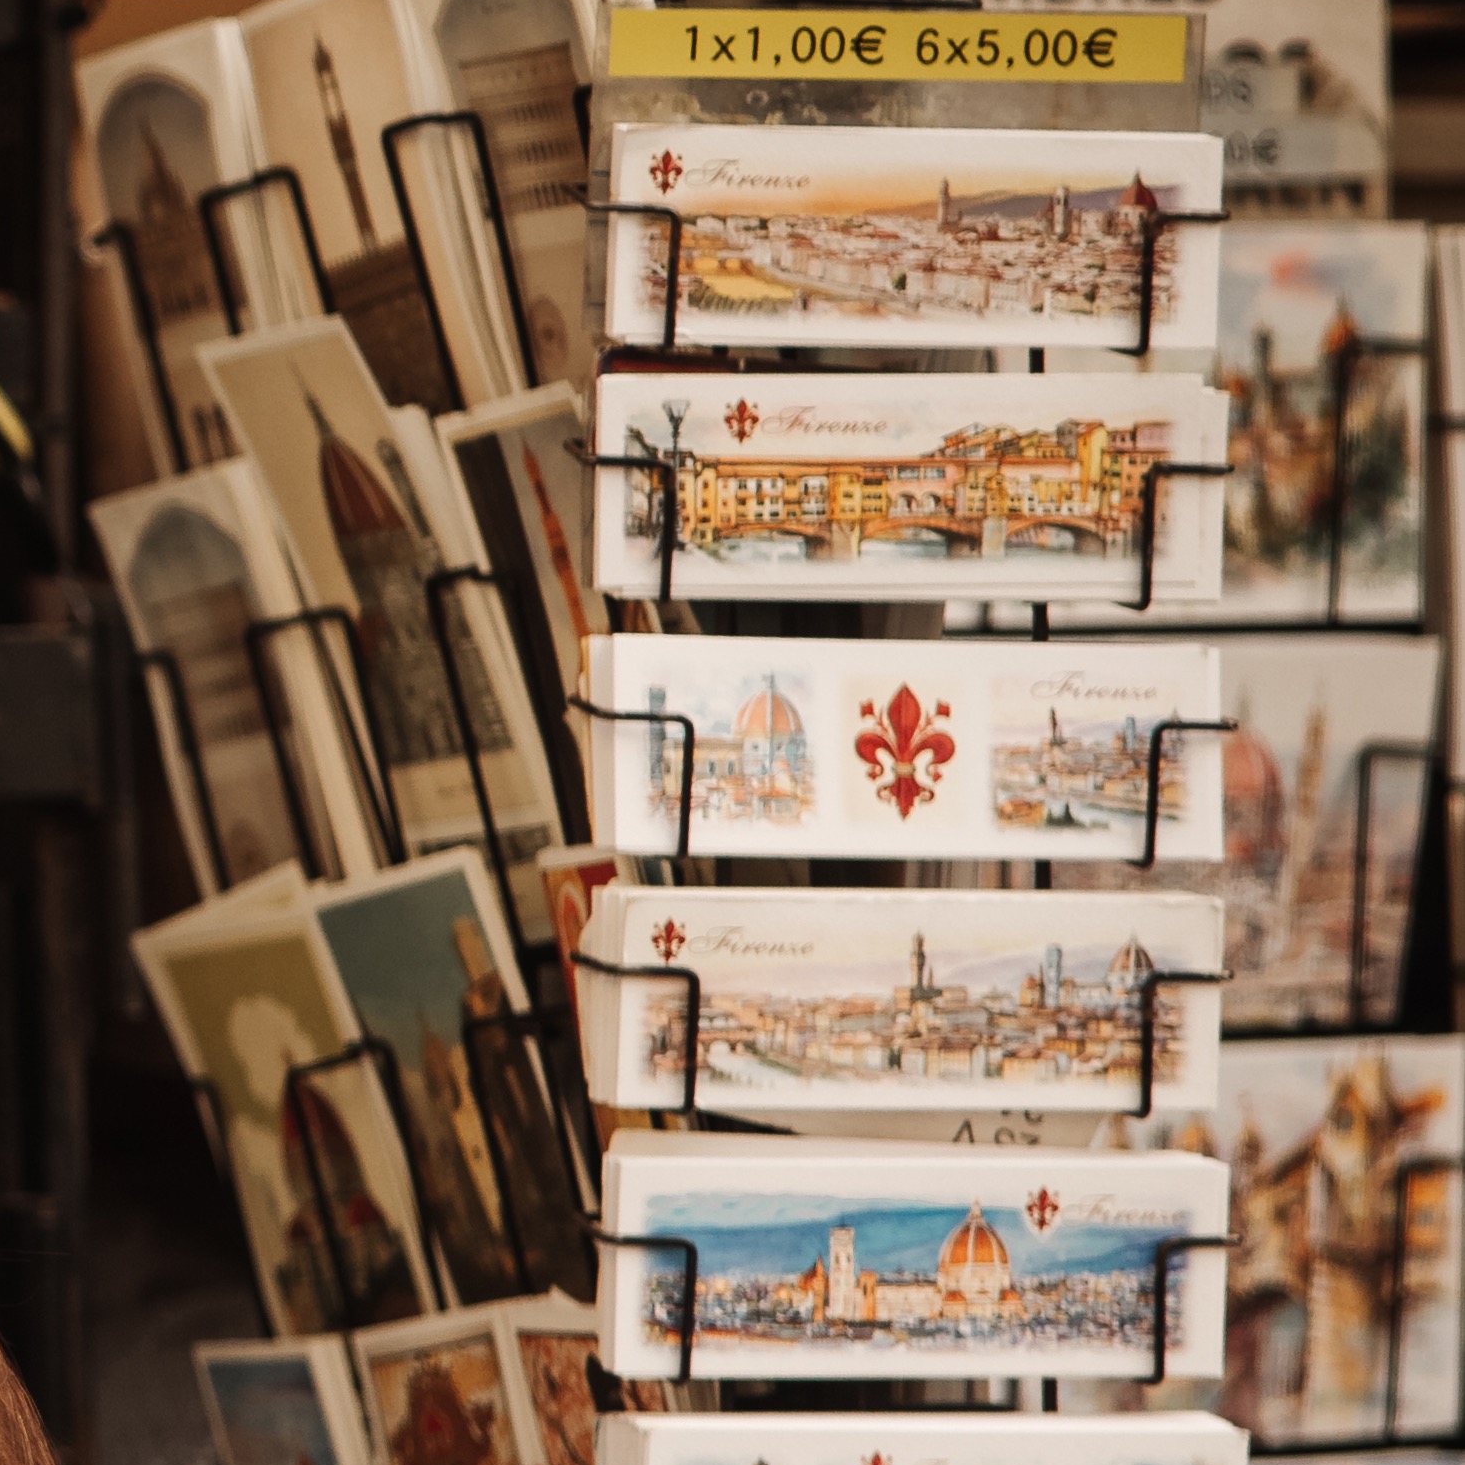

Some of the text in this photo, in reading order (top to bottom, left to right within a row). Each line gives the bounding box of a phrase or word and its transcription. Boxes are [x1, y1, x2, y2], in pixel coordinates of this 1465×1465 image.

[685, 24, 1119, 71] 1x1,00€ 6x5,00€
[684, 159, 810, 188] Firenze
[761, 405, 888, 435] Firenze
[1030, 670, 1157, 699] Firenze
[687, 926, 814, 955] Firenze
